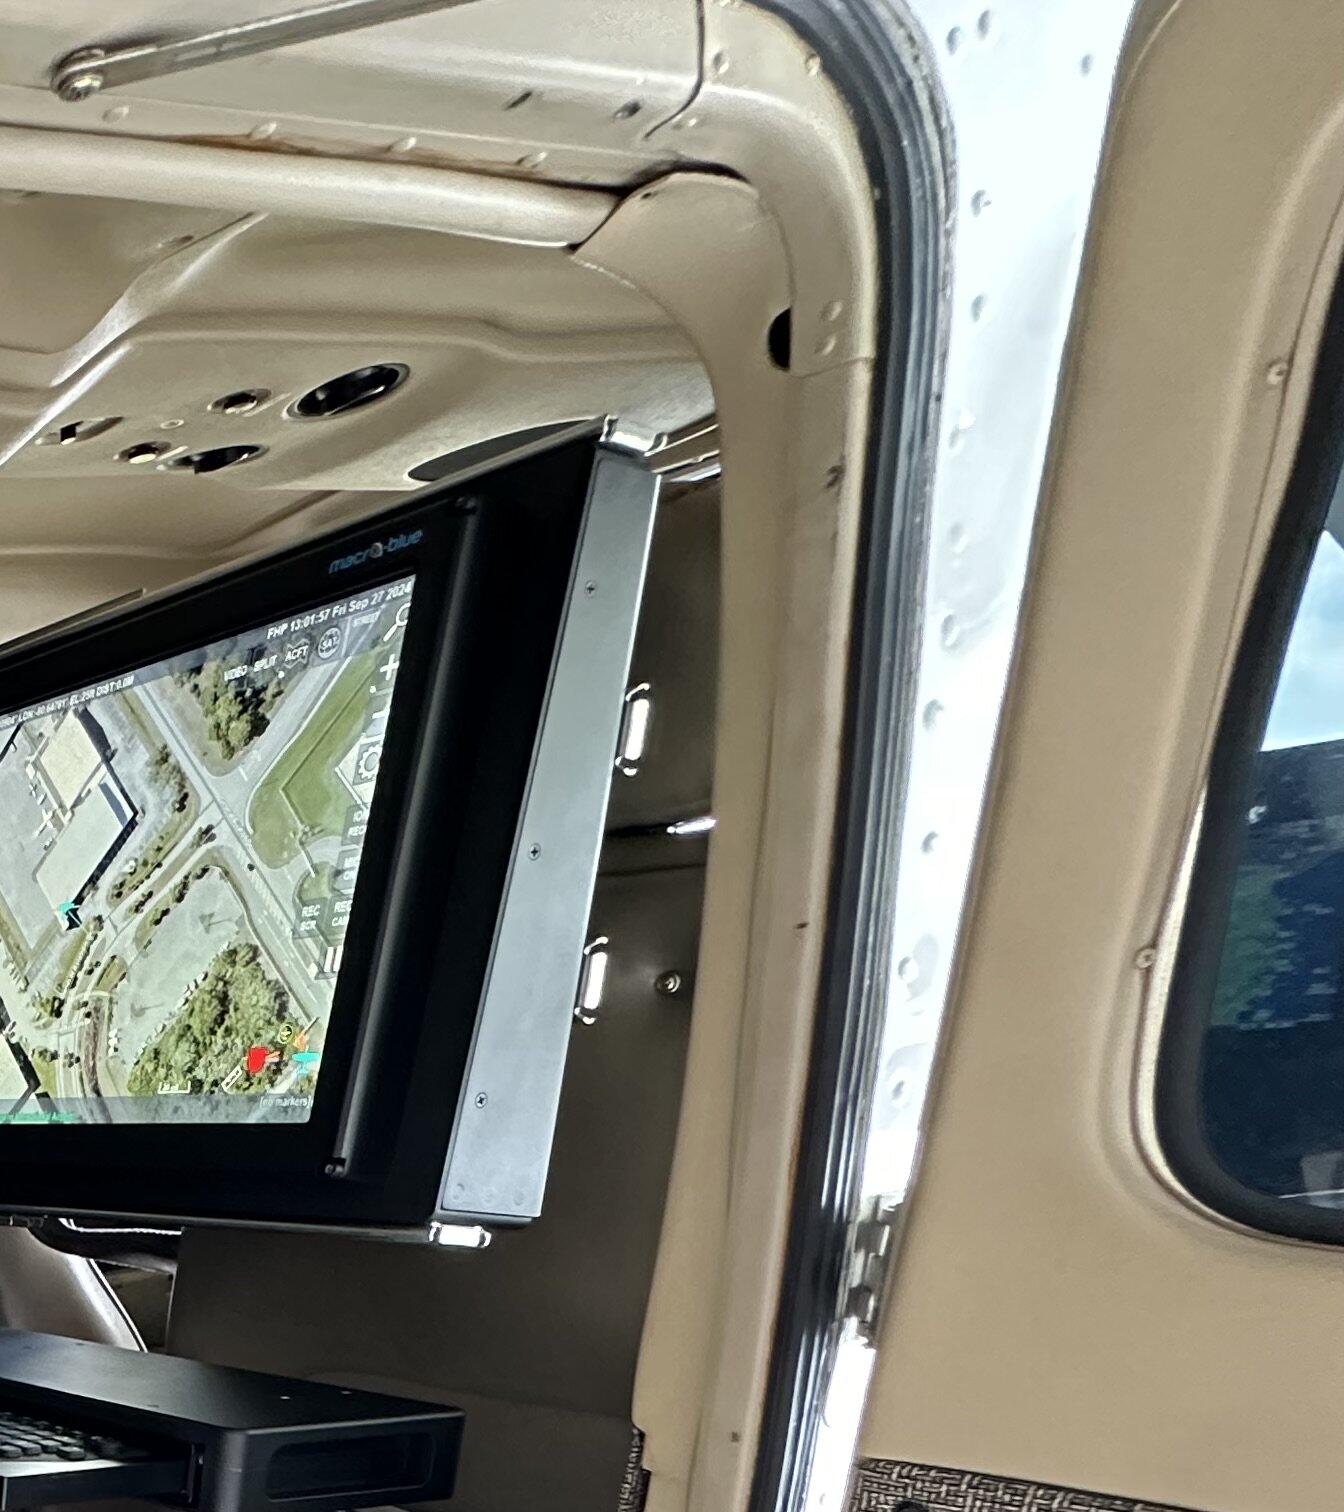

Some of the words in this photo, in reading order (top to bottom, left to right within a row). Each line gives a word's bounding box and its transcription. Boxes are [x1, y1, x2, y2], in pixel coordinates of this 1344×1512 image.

[290, 608, 331, 632] 13:01:57
[332, 603, 347, 619] Fri
[348, 596, 369, 614] Sep
[370, 592, 383, 605] 27
[385, 580, 413, 599] 2024
[285, 645, 309, 662] ACFT
[302, 904, 320, 917] REC
